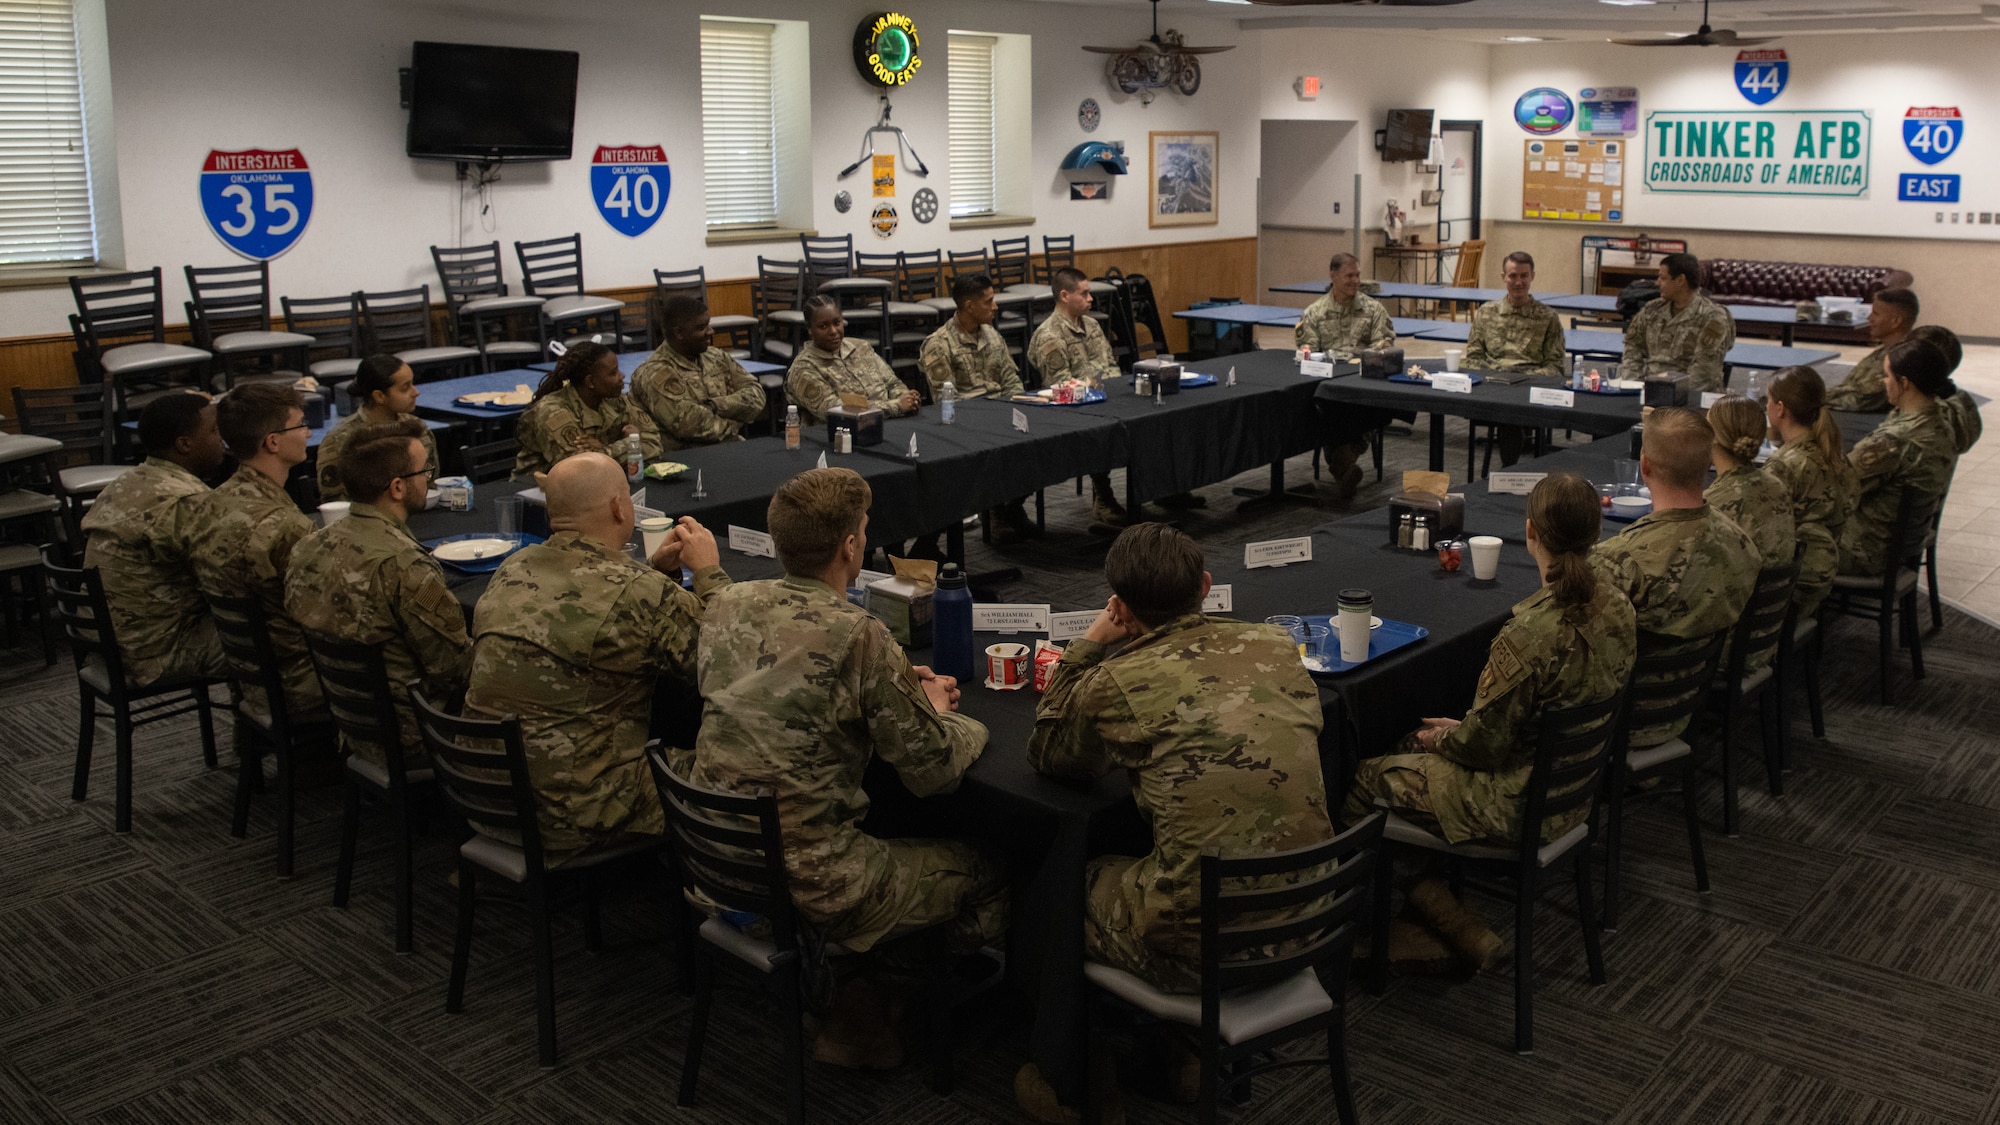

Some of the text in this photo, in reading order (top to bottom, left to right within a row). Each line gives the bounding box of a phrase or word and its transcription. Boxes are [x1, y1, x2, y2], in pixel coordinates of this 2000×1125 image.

[868, 53, 922, 86] GOOD EATS
[1741, 67, 1780, 94] 44
[1654, 121, 1861, 159] TINKER AFB
[1910, 125, 1954, 154] 40
[215, 154, 296, 170] INTERSTATE
[602, 149, 659, 162] INTERSTATE
[230, 174, 283, 183] OKLAHOMA
[612, 166, 649, 175] OKLAHOMA
[1650, 161, 1862, 186] CROSSROADS OF AMERICA
[604, 174, 659, 218] 40
[1906, 178, 1952, 197] EAST
[220, 184, 299, 237] 35
